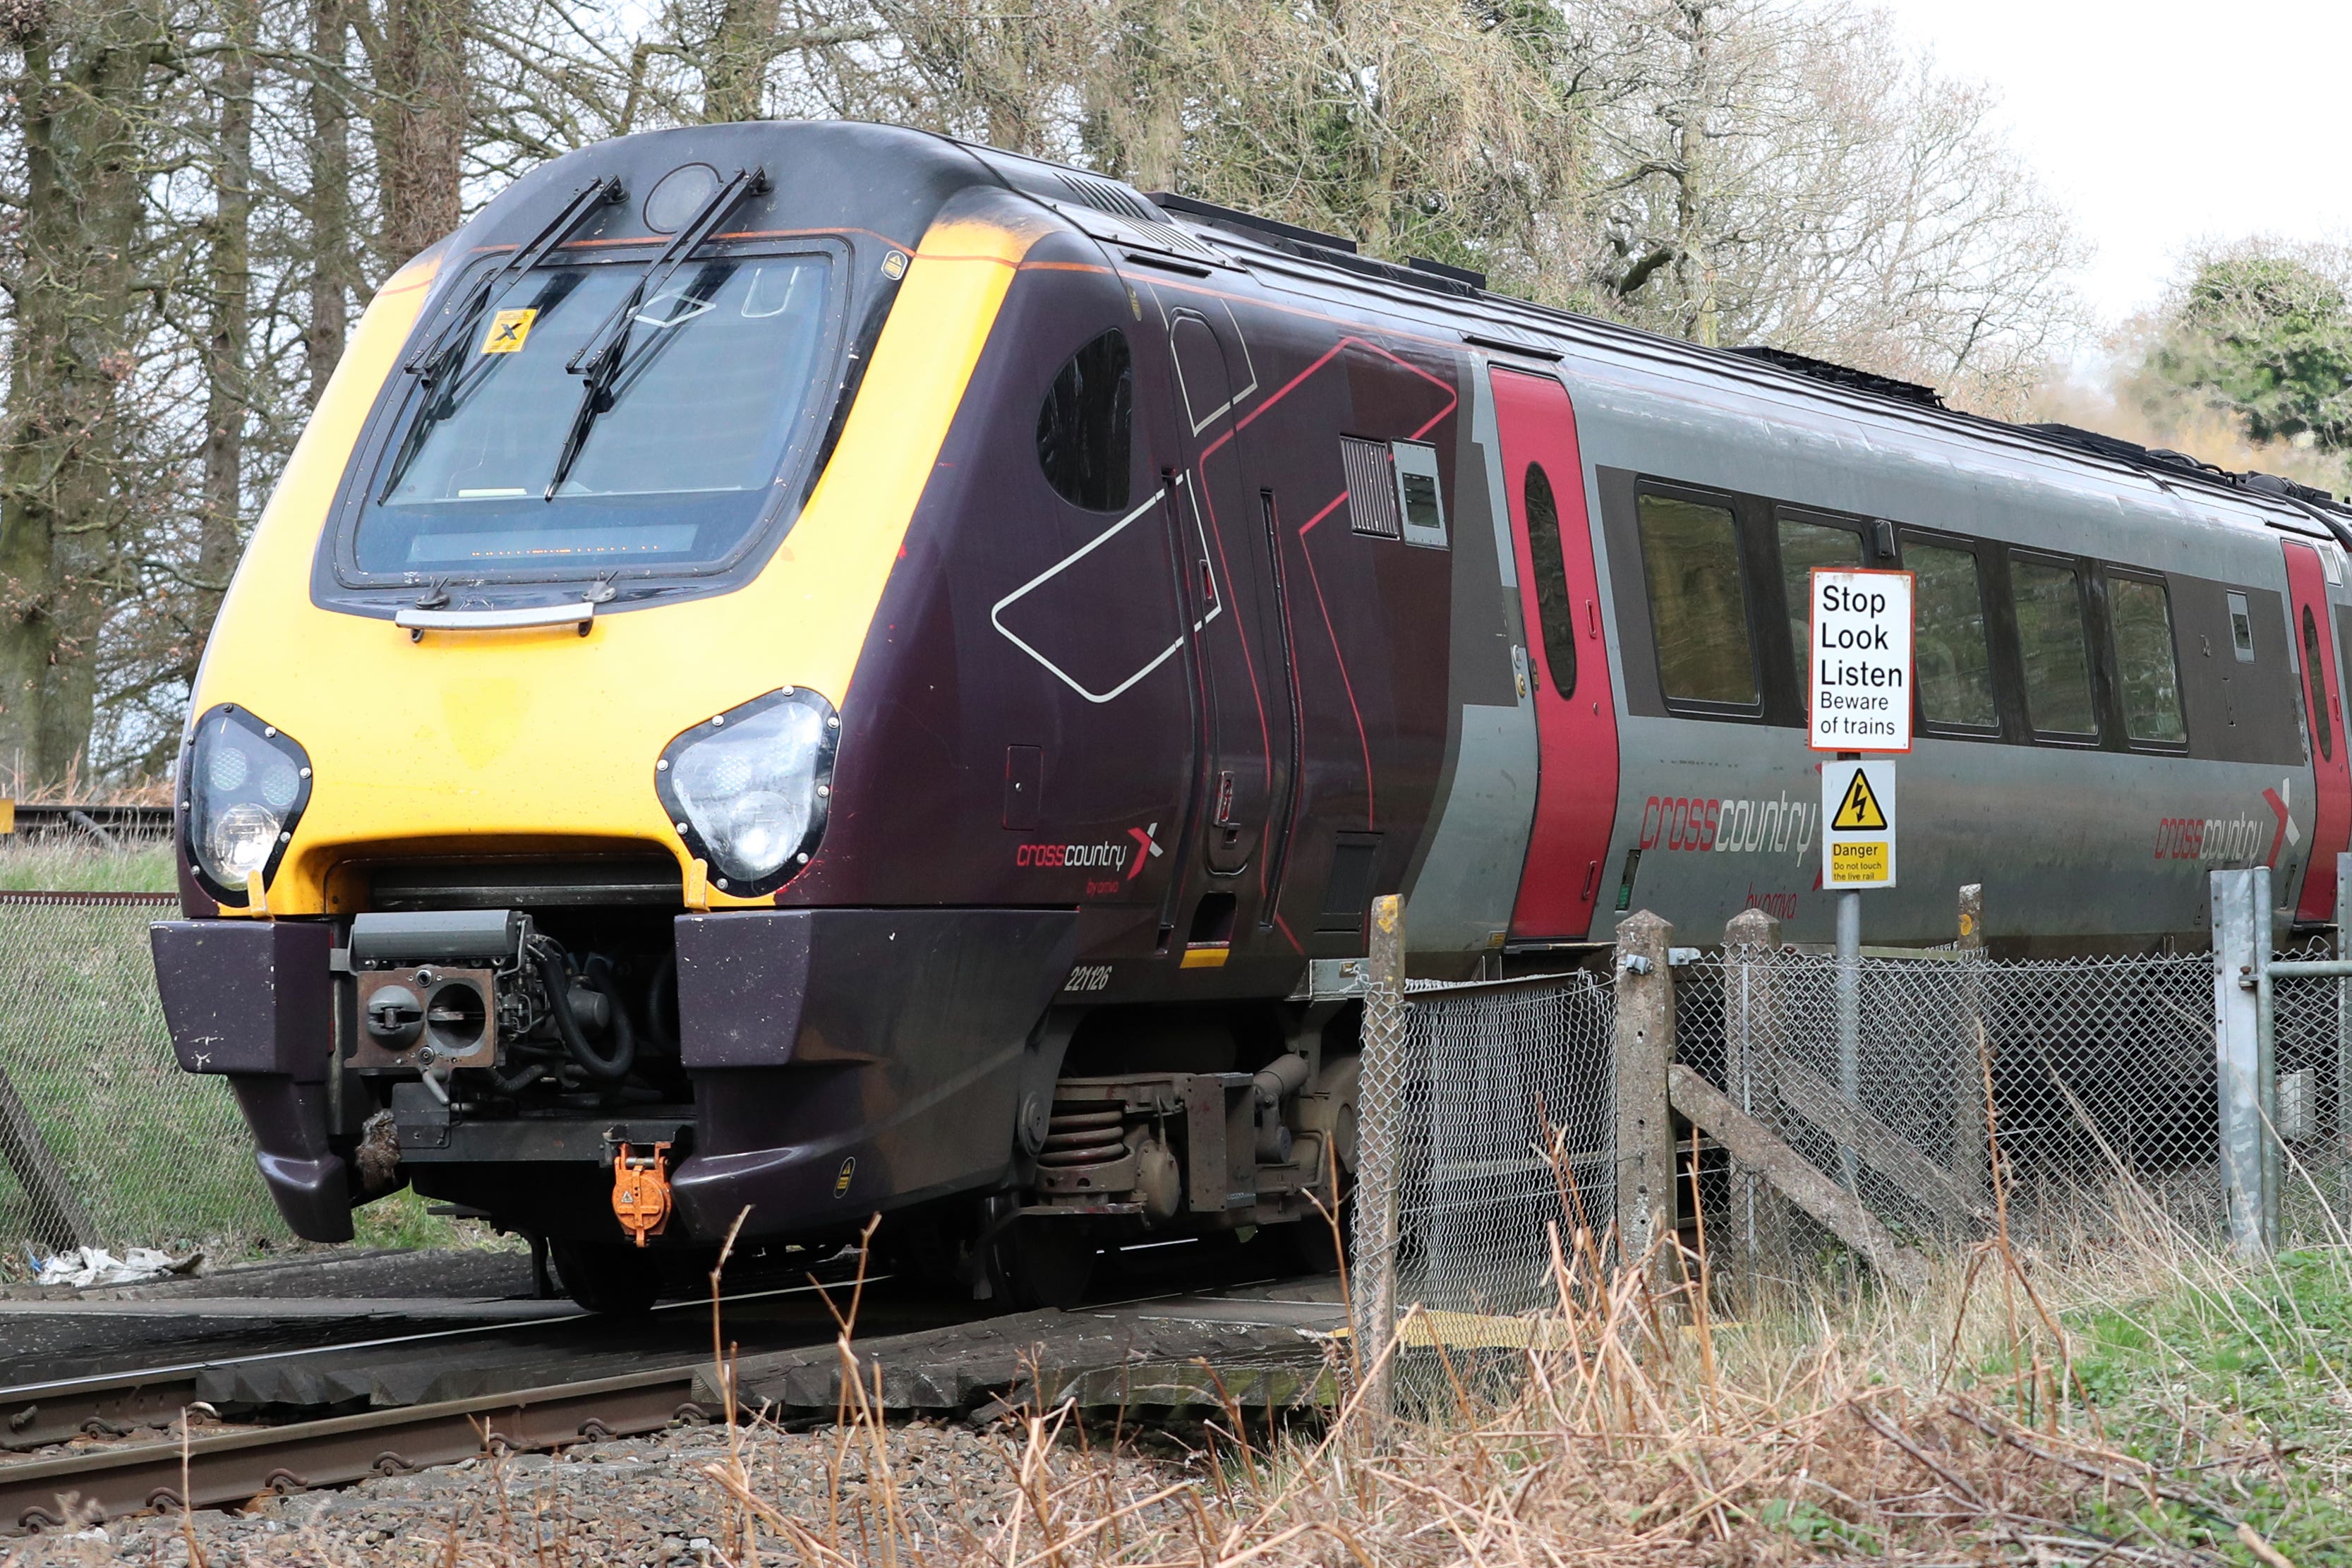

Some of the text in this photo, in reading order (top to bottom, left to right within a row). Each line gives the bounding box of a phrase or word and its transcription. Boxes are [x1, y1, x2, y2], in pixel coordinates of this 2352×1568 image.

[1823, 584, 1886, 619] Stop
[1822, 622, 1889, 650] Look
[1821, 659, 1902, 687] Listen
[1821, 691, 1889, 711] Beware
[1821, 716, 1895, 735] of trains
[1833, 843, 1878, 859] Danger
[1833, 861, 1882, 870] Do not touch
[1833, 872, 1874, 881] the live rail
[1063, 965, 1113, 991] 221126
